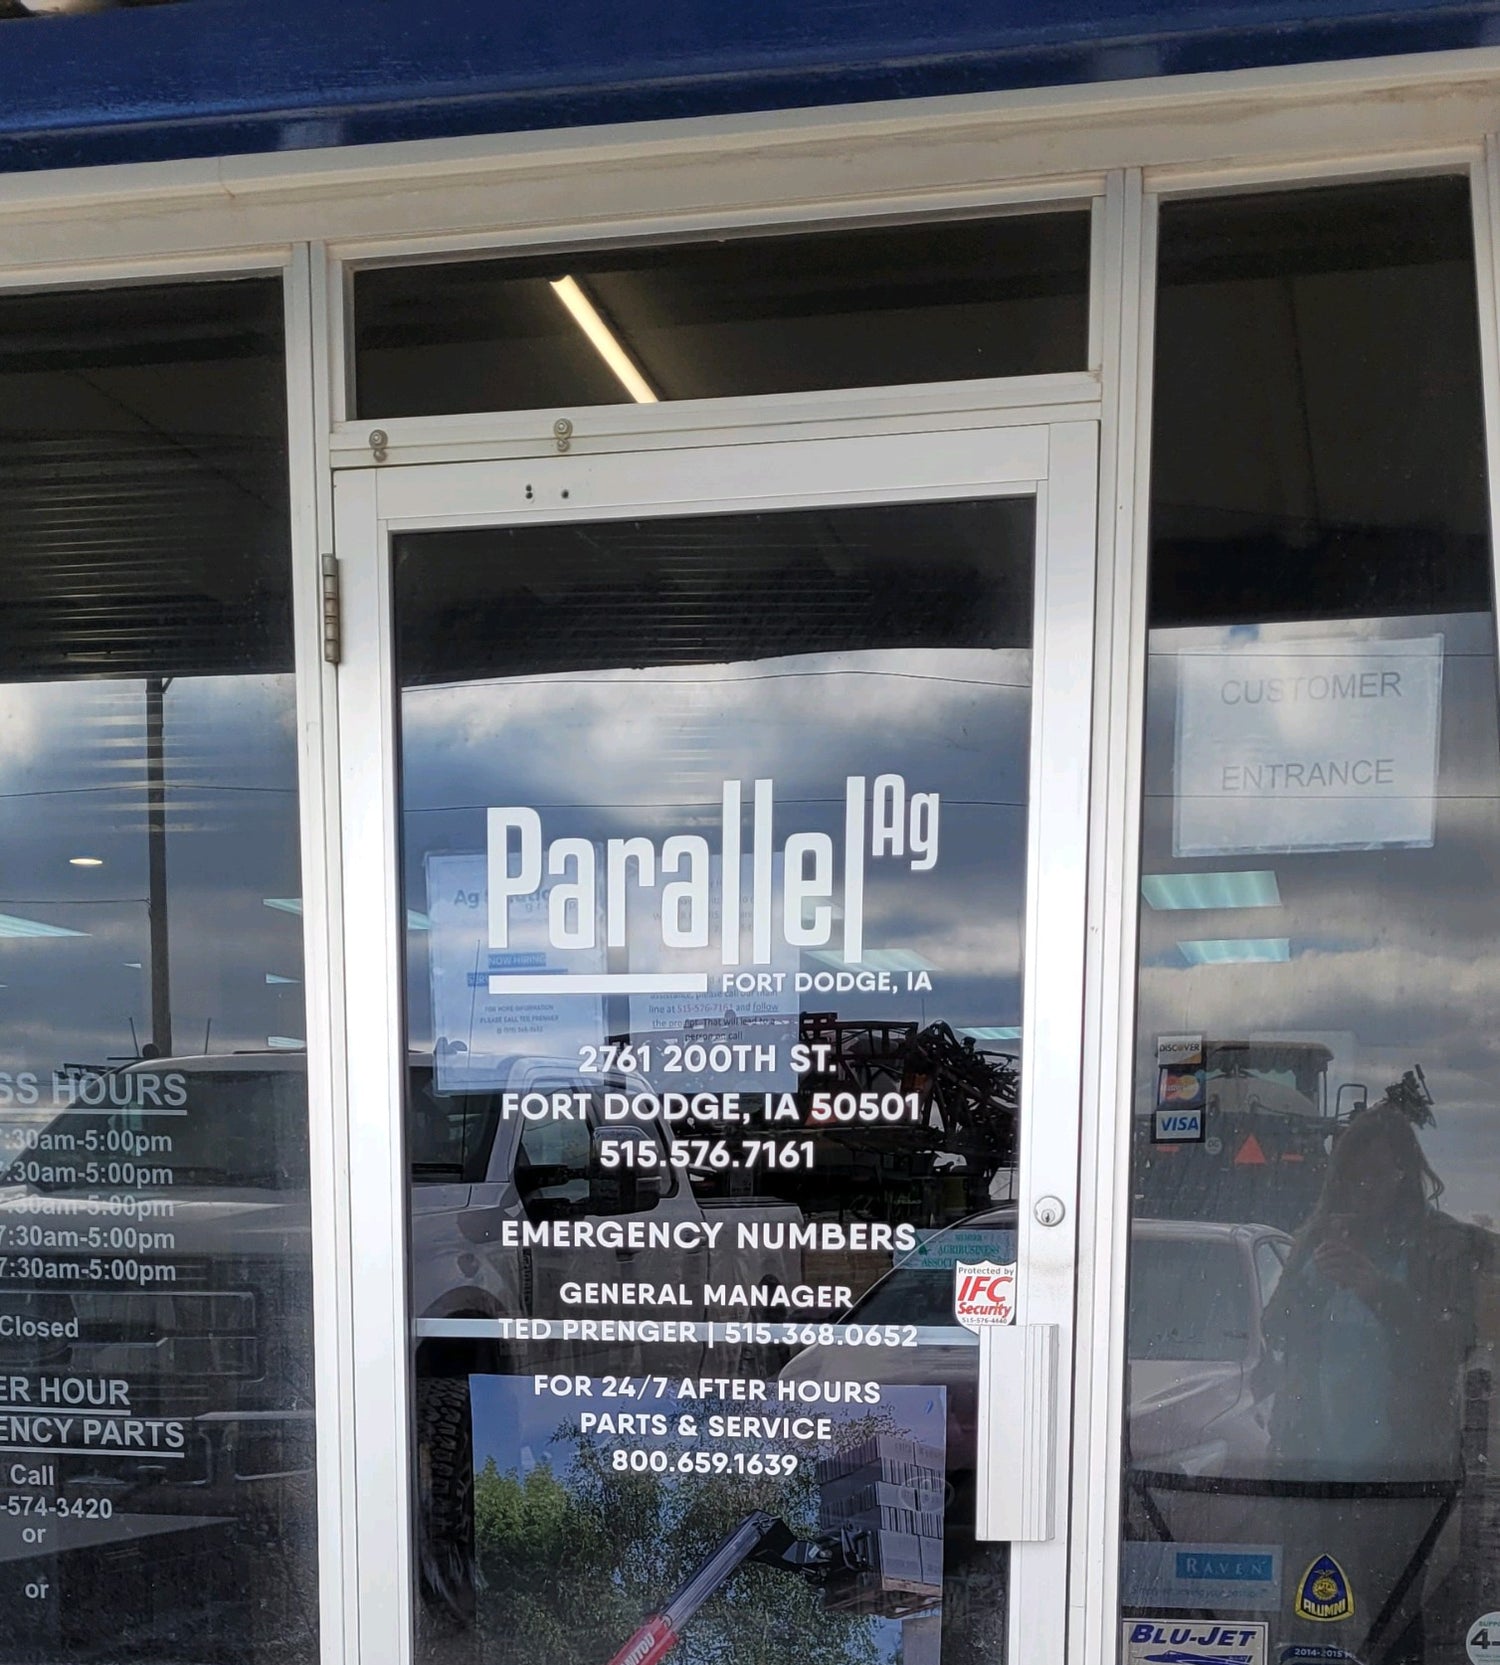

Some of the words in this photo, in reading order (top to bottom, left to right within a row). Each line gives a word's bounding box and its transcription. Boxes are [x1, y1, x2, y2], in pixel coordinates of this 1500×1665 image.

[1221, 672, 1401, 705] CUSTOMER
[1221, 758, 1395, 791] ENTRANCE
[486, 775, 866, 966] Parallel
[872, 773, 940, 871] Ag
[453, 889, 481, 909] Ag
[721, 972, 787, 993] FORT
[795, 972, 898, 995] DODGE,
[907, 971, 932, 991] IA
[649, 1005, 664, 1013] line
[667, 1005, 675, 1013] at
[735, 1003, 750, 1012] and
[752, 1001, 778, 1013] follow
[652, 1018, 667, 1027] the
[729, 1030, 742, 1040] call
[579, 1045, 650, 1073] 2761
[663, 1044, 776, 1073] 200TH
[790, 1044, 836, 1072] ST.
[1159, 1043, 1200, 1052] DISCOVER
[53, 1072, 188, 1106] HOURS
[502, 1093, 592, 1120] FORT
[604, 1092, 750, 1124] DODGE,
[765, 1093, 799, 1120] IA
[811, 1092, 919, 1121] 50501
[1161, 1117, 1199, 1131] VISA
[0, 1129, 173, 1156] :30am-5:00pm
[600, 1140, 813, 1168] 515.576.7161
[502, 1220, 723, 1249] EMERGENCY
[738, 1222, 916, 1251] NUMBERS
[958, 1266, 1001, 1274] Protected
[1004, 1267, 1014, 1276] by
[559, 1282, 693, 1305] GENERAL
[704, 1284, 853, 1308] MANAGER
[957, 1276, 1013, 1303] IFC
[957, 1301, 1012, 1319] Security
[0, 1315, 79, 1338] Closed
[500, 1317, 550, 1340] TED
[561, 1318, 697, 1344] PRENGER
[723, 1320, 918, 1348] 515.368.0652
[40, 1377, 131, 1406] HOUR
[534, 1374, 593, 1397] FOR
[602, 1375, 668, 1399] 24/7
[677, 1377, 767, 1401] AFTER
[778, 1380, 880, 1404] HOURS
[83, 1419, 185, 1448] PARTS
[581, 1412, 667, 1436] PARTS
[677, 1414, 697, 1436] &
[708, 1415, 832, 1440] SERVICE
[10, 1463, 54, 1486] Call
[612, 1449, 798, 1476] 800.659.1639
[22, 1527, 46, 1543] or
[1186, 1557, 1263, 1575] RAVEN
[25, 1582, 49, 1599] or
[1303, 1598, 1347, 1617] ALUMNI
[1130, 1624, 1257, 1647] BLU-JET
